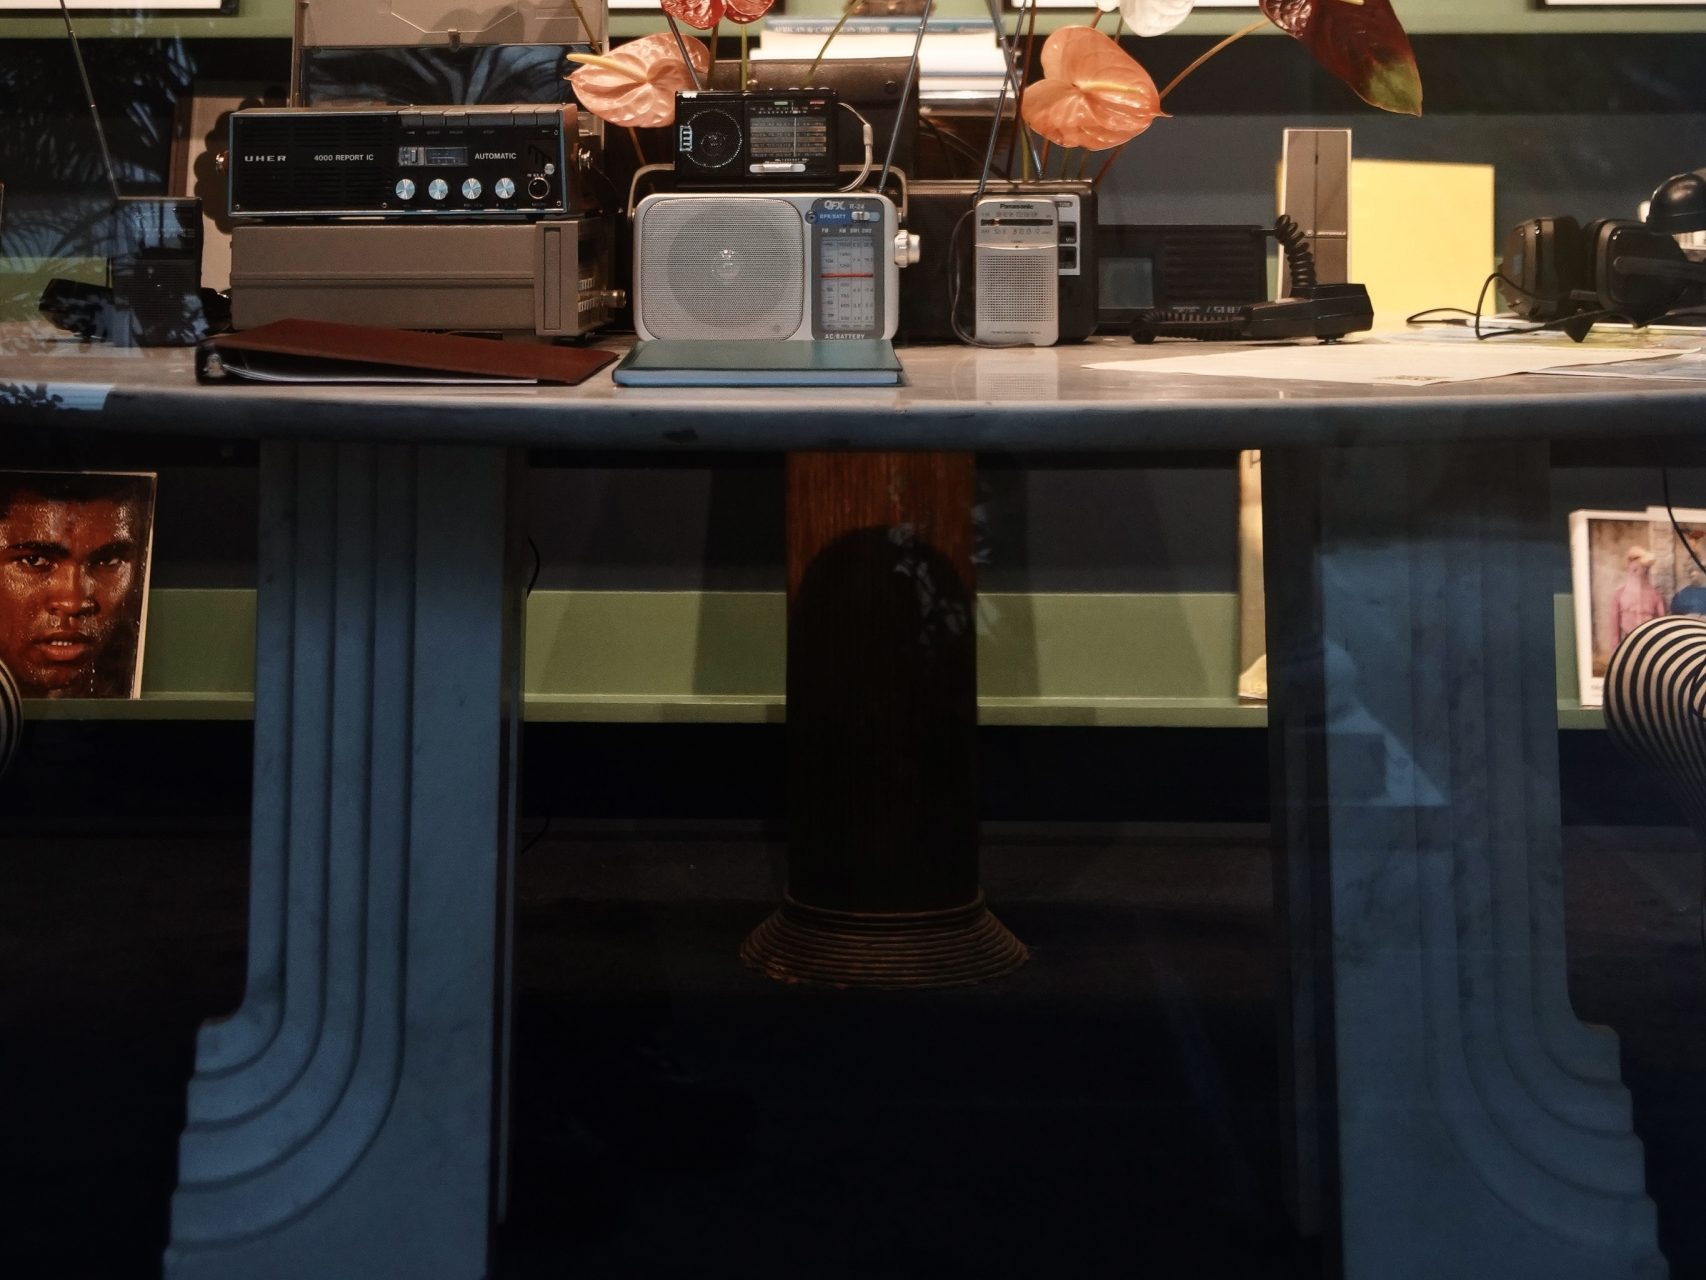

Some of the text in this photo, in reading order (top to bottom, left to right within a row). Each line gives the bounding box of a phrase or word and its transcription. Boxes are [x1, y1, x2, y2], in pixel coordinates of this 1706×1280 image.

[244, 154, 287, 162] UHER
[474, 152, 517, 160] AUTOMATIC
[823, 200, 846, 210] QFX
